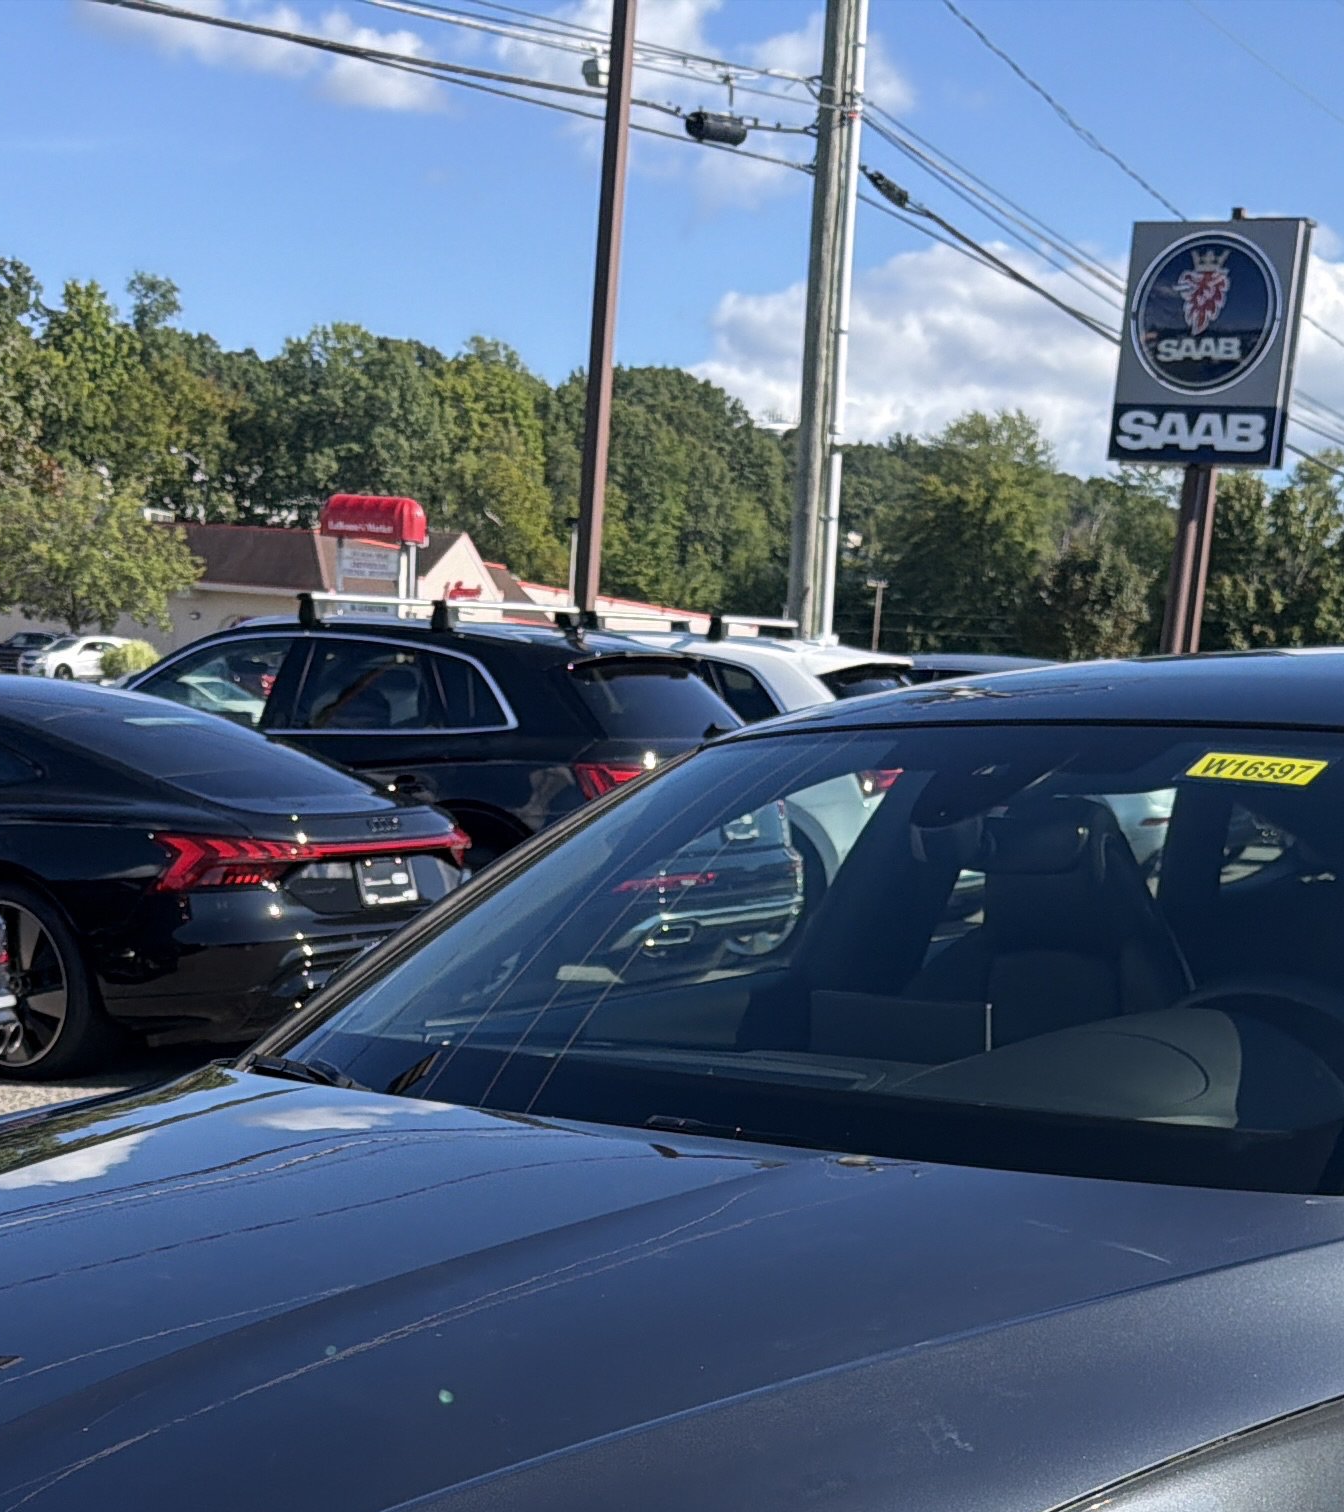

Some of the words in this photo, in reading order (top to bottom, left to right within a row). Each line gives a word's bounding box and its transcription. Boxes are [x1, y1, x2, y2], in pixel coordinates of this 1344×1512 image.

[1156, 336, 1242, 362] SAAB
[1115, 409, 1267, 453] SAAB
[1202, 757, 1315, 781] W16597
